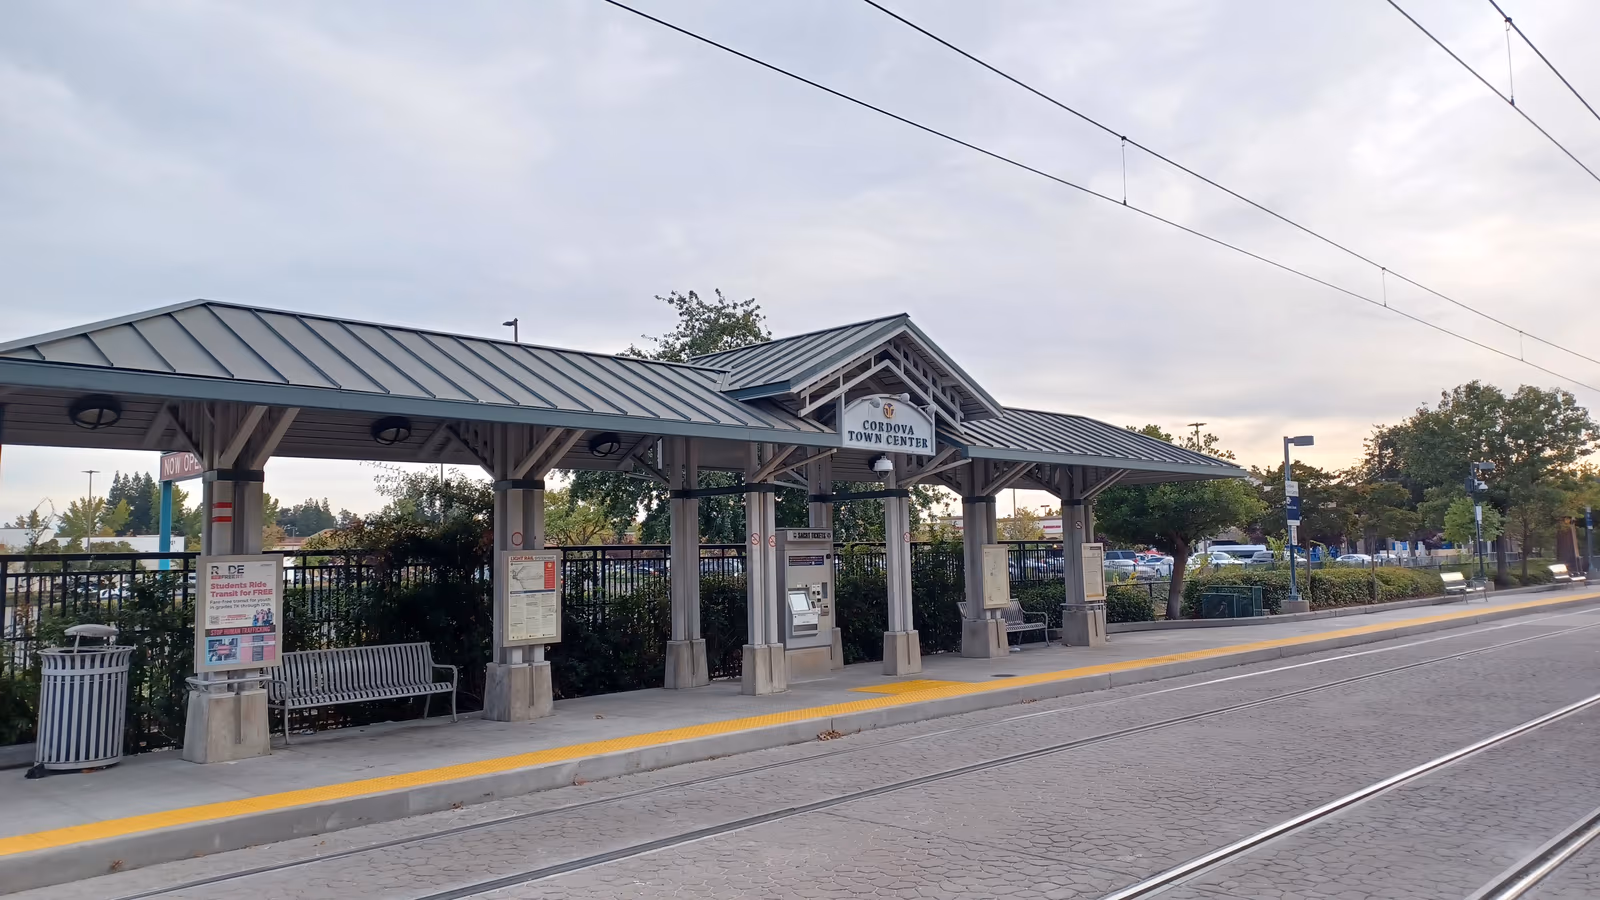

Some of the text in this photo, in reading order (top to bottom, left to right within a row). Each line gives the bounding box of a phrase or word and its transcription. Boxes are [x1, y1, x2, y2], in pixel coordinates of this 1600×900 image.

[863, 420, 914, 435] CORDOVA
[848, 430, 928, 448] TOWN CENTER
[164, 453, 202, 476] NOW OPE
[210, 582, 247, 590] Students
[210, 590, 238, 598] Transit
